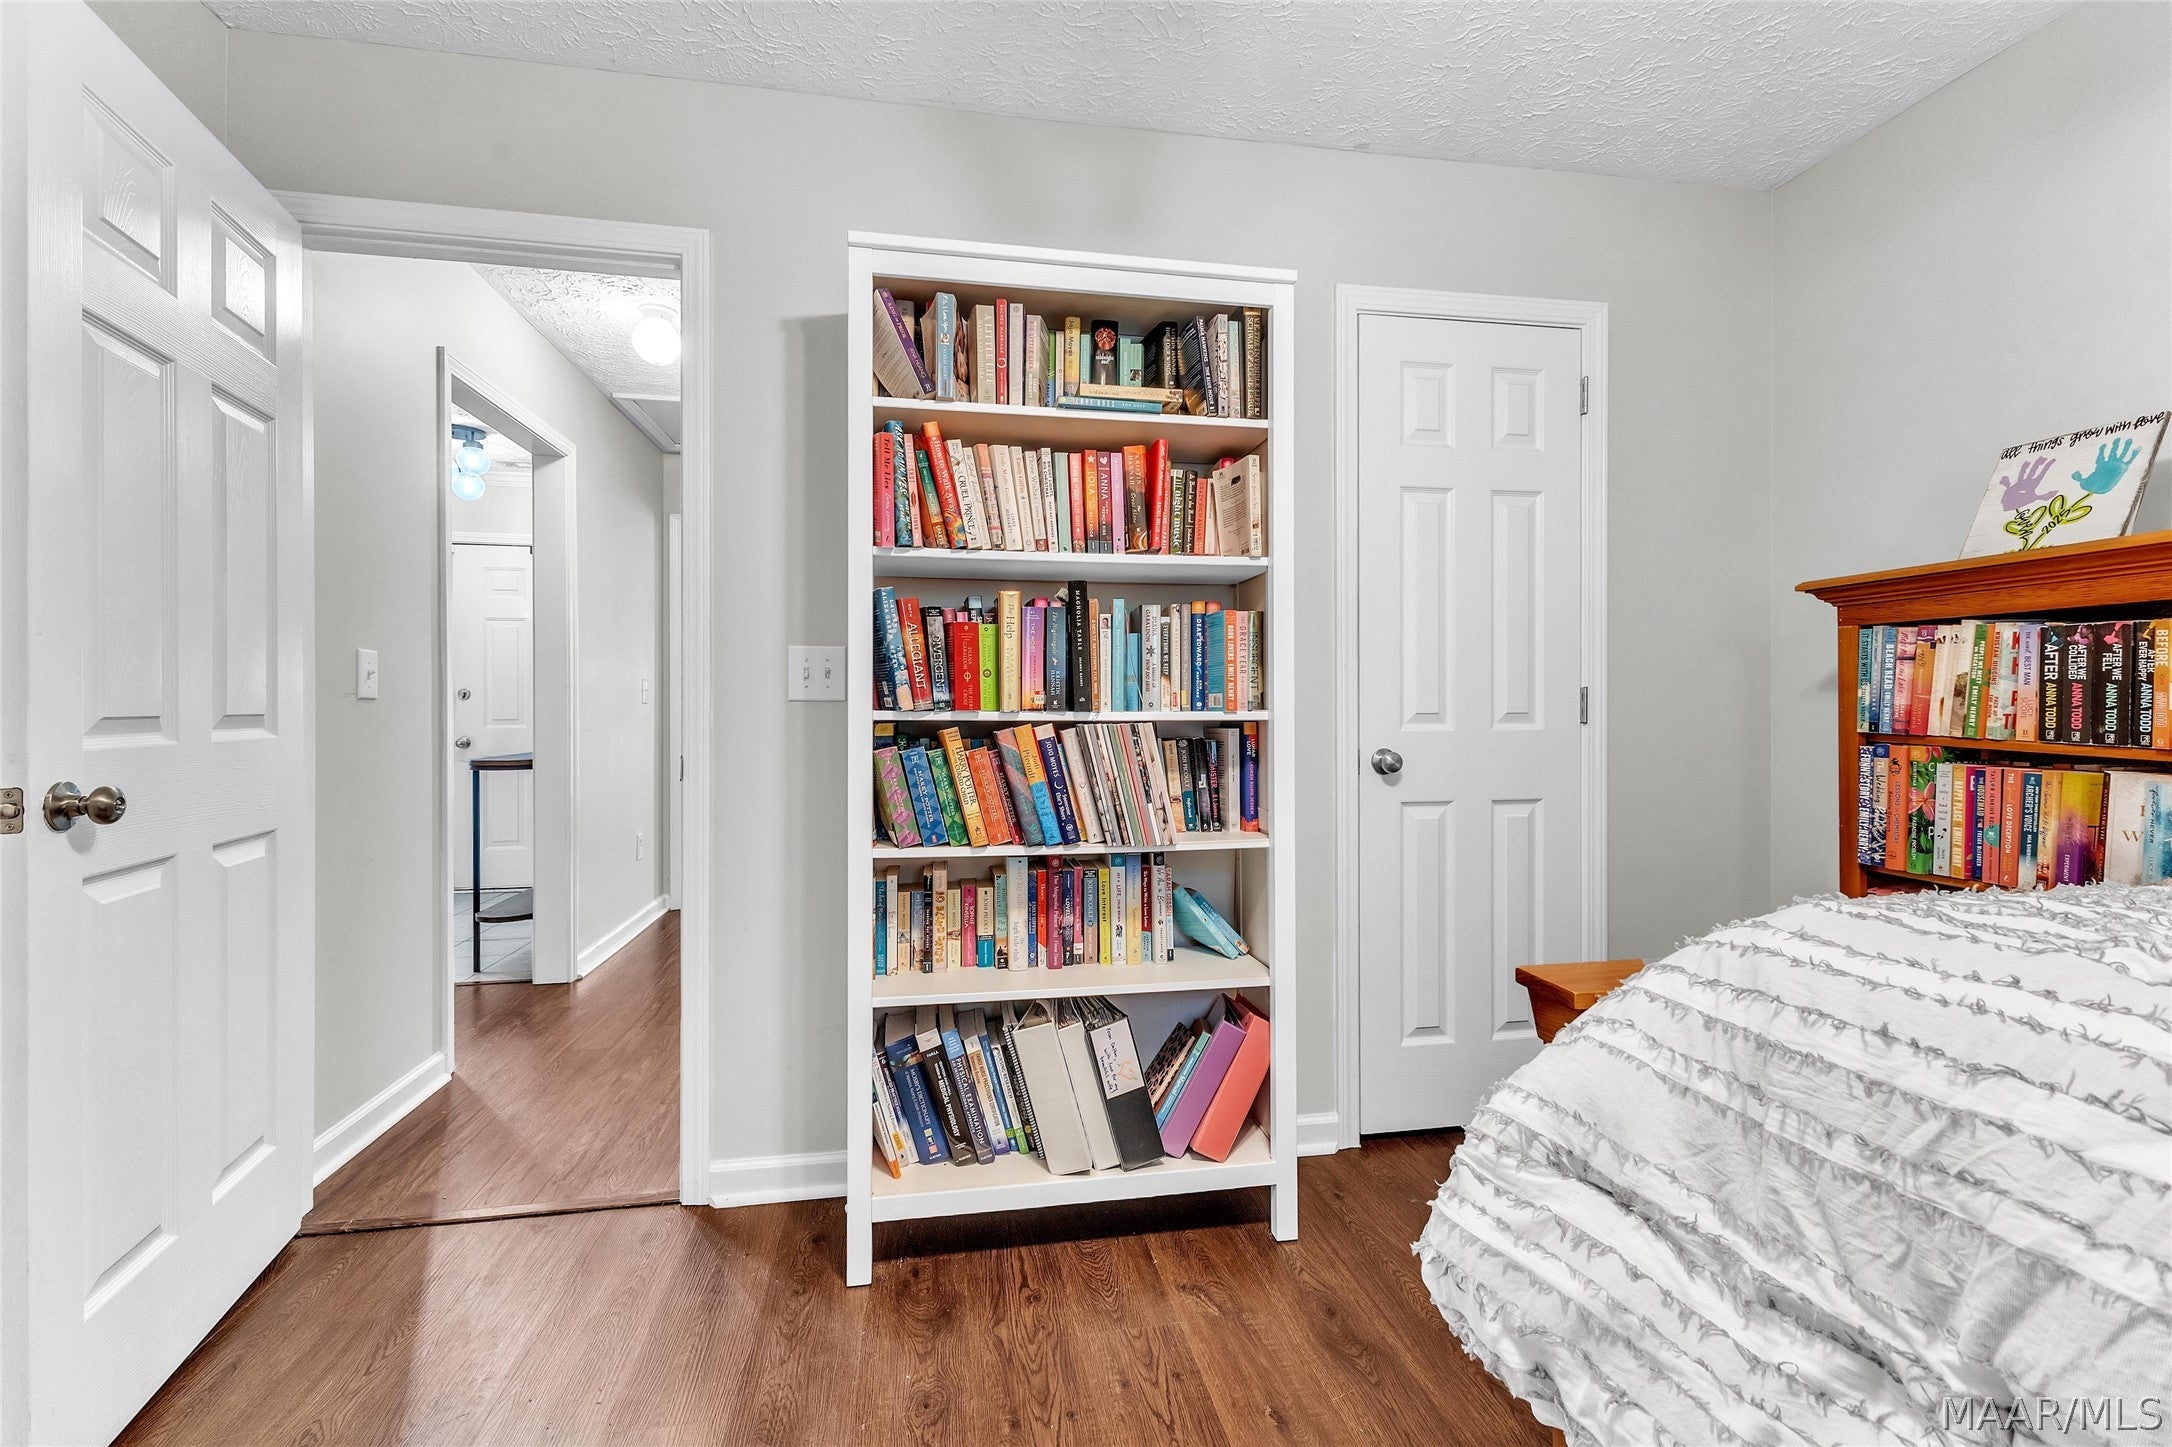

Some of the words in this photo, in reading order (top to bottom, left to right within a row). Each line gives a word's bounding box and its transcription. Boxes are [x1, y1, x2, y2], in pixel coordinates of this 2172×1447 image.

[985, 323, 993, 360] LITTLE
[1200, 336, 1209, 362] HAWKINS
[985, 362, 994, 386] LIFE
[894, 424, 903, 442] ASK
[2028, 436, 2065, 455] things
[2069, 428, 2102, 448] grow
[2104, 421, 2132, 436] with
[884, 457, 890, 470] Me
[934, 440, 942, 458] How
[946, 492, 955, 512] Away
[1100, 472, 1108, 500] ANNA
[958, 475, 968, 501] CRUEL
[964, 503, 974, 531] PRINCE
[1173, 490, 1181, 516] night
[928, 493, 940, 523] NICHOLAS
[936, 524, 944, 545] SPARKS
[2041, 508, 2071, 535] 2025
[1172, 517, 1181, 548] music
[1003, 616, 1015, 639] Help
[907, 622, 926, 690] ALLEGIANT
[1861, 640, 1870, 660] STARTS
[1884, 644, 1895, 668] BEACH
[1992, 631, 2001, 658] KRISTAN
[2077, 644, 2086, 668] AFTER
[2112, 643, 2122, 668] AFTER
[2138, 641, 2147, 659] EVER
[2155, 629, 2169, 667] BEFORE
[932, 634, 945, 695] DIVERGENT
[1239, 655, 1247, 674] YEAR
[1250, 631, 1259, 691] INSURGENT
[1860, 661, 1869, 677] WITH
[1970, 653, 1978, 679] VACATION
[2023, 655, 2031, 671] BEST
[2044, 643, 2059, 681] AFTER
[2068, 644, 2078, 680] COLLIDED
[2102, 652, 2112, 672] FELL
[2137, 659, 2147, 681] HAPPY
[2147, 649, 2155, 673] AFTER
[1860, 677, 1869, 687] US
[1883, 670, 1893, 689] READ
[1897, 677, 1907, 694] Lake
[1990, 660, 1999, 687] HIGGINS
[2023, 671, 2031, 686] MAN
[2077, 668, 2086, 681] WE
[2111, 668, 2122, 681] WE
[1883, 691, 1891, 706] EMILY
[1970, 685, 1979, 705] EMILY
[2045, 682, 2057, 707] ANNA
[2071, 682, 2083, 707] ANNA
[2105, 682, 2118, 708] ANNA
[2139, 682, 2152, 709] ANNA
[2155, 691, 2167, 710] ANNA
[1882, 706, 1890, 723] HENRY
[1968, 706, 1977, 727] HENRY
[2020, 696, 2028, 720] SCORE
[2027, 699, 2035, 718] LUCY
[2045, 706, 2057, 729] TODD
[2071, 707, 2083, 730] TODD
[2105, 708, 2117, 731] TODD
[2139, 709, 2153, 733] TODD
[955, 746, 970, 774] HARRY
[1045, 740, 1054, 756] JOJO
[1022, 748, 1035, 779] Picoult
[1031, 754, 1039, 770] Jodi
[1049, 756, 1060, 778] MOYES
[1859, 753, 1871, 777] FUNNY
[1876, 760, 1885, 771] The
[954, 764, 964, 787] CURSED
[960, 787, 969, 805] CHILD
[1182, 764, 1190, 787] PICOULT
[1210, 764, 1218, 789] MISTER
[917, 770, 928, 796] HARRY
[925, 797, 934, 823] POTTER
[962, 775, 975, 806] POTTER
[1859, 778, 1871, 799] STORY
[1873, 774, 1886, 803] Wedding
[1953, 780, 1964, 802] HAPPY
[1976, 784, 1985, 817] HOUSEMAID
[2024, 784, 2034, 814] ARCHER'S
[1858, 807, 1871, 826] EMILY
[1953, 802, 1963, 822] PLACE
[2023, 814, 2033, 833] VOICE
[1858, 828, 1871, 851] HENRY
[1953, 826, 1963, 846] EMILY
[2004, 820, 2013, 854] DECEPTION
[1952, 847, 1963, 868] HENRY
[935, 891, 945, 903] 10
[935, 905, 945, 934] BLIND
[926, 1050, 940, 1058] HALL
[1103, 1048, 1111, 1059] with
[917, 1091, 930, 1126] DICTIONARY
[954, 1057, 970, 1092] PHYSICAL
[965, 1093, 985, 1144] EXAMINATION
[945, 1103, 961, 1137] PHYSIOLOGY
